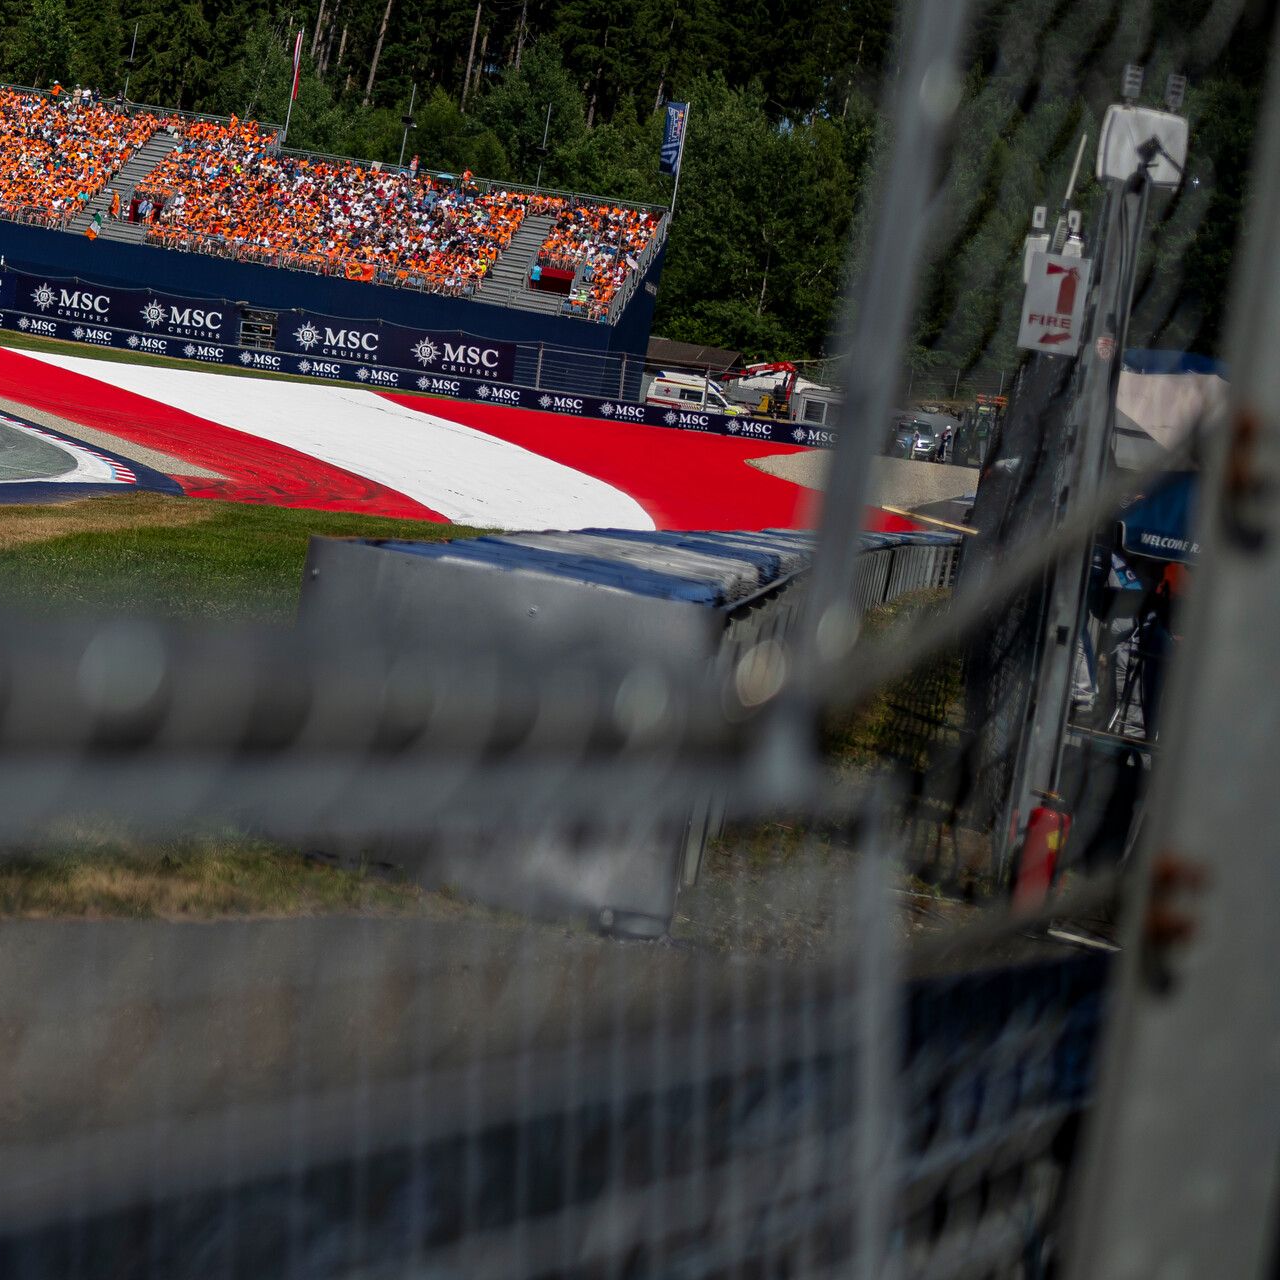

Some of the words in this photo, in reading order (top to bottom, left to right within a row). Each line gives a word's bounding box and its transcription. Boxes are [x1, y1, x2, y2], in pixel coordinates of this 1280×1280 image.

[59, 289, 110, 313] MSC
[58, 309, 108, 323] CRUISES
[171, 306, 222, 329] MSC
[1028, 314, 1072, 329] FIRE
[31, 320, 56, 332] MSC
[86, 329, 112, 340] MSC
[168, 326, 220, 339] CRUISES
[141, 337, 167, 349] MSC
[324, 328, 378, 351] MSC
[198, 346, 223, 357] MSC
[323, 348, 377, 361] CRUISES
[443, 343, 498, 367] MSC
[254, 354, 280, 366] MSC
[313, 362, 340, 373] MSC
[442, 364, 498, 377] CRUISES
[371, 370, 398, 382] MSC
[432, 379, 459, 391] MSC
[492, 388, 520, 400] MSC
[554, 397, 582, 409] MSC
[616, 405, 644, 417] MSC
[679, 413, 708, 425] MSC
[742, 422, 771, 434] MSC
